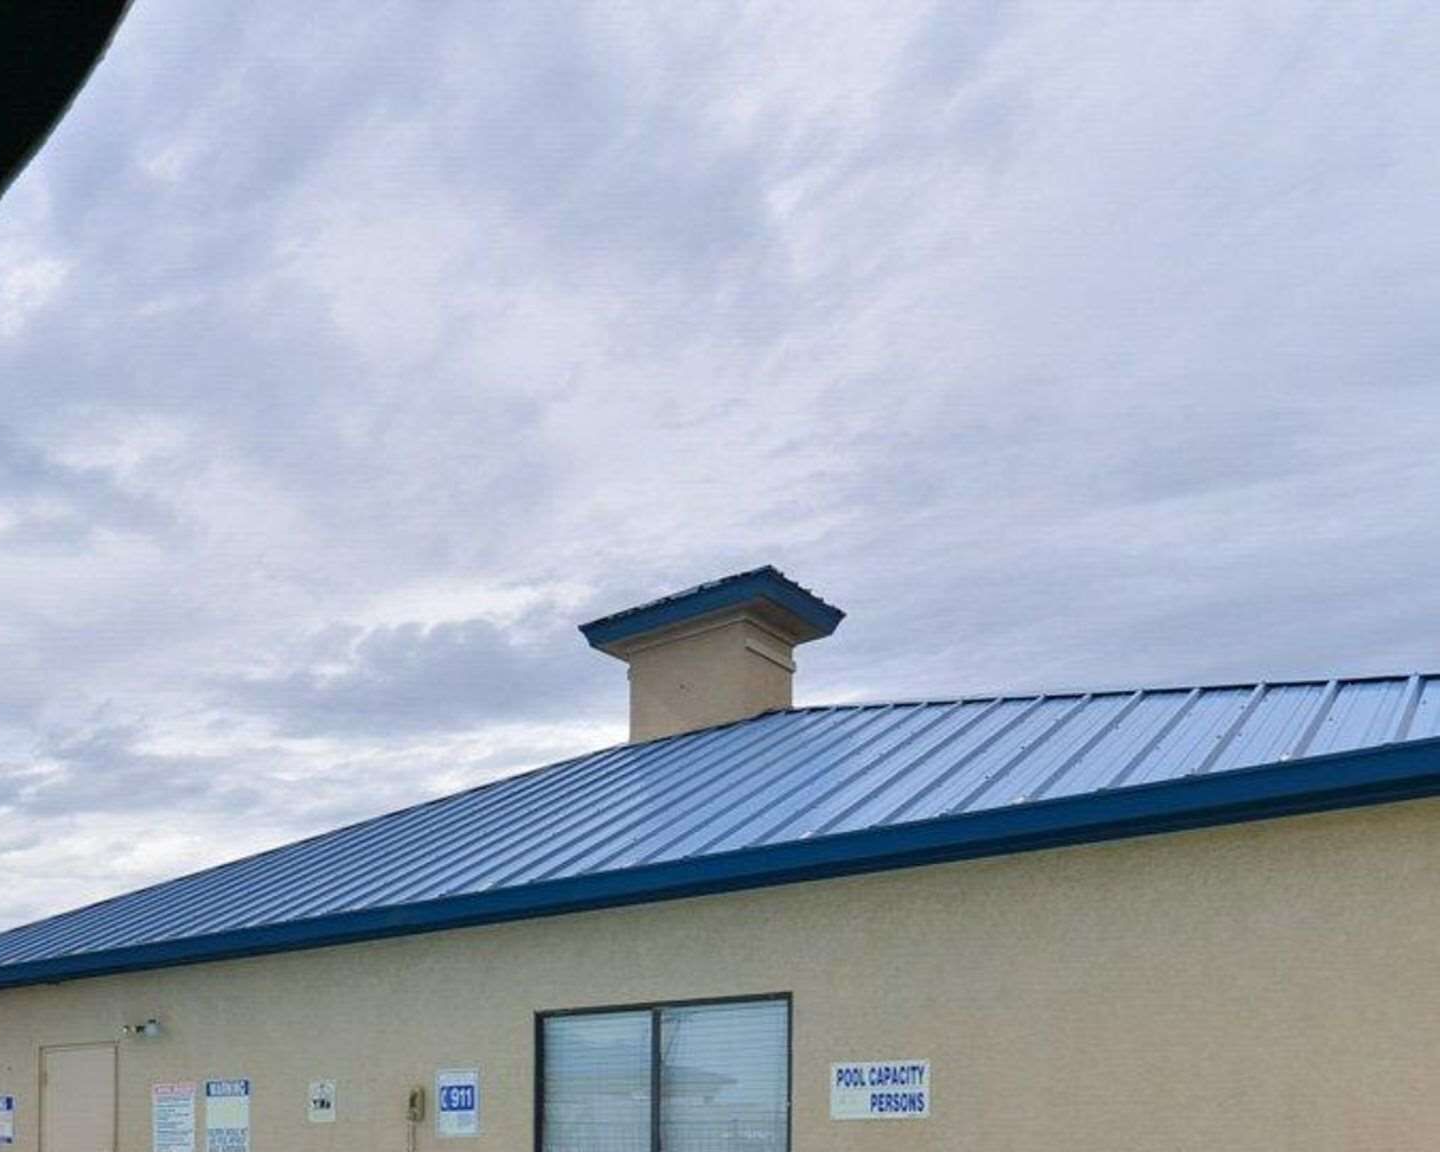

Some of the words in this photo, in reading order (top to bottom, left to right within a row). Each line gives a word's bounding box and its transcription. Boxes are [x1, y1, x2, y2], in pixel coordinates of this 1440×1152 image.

[836, 1068, 866, 1087] POOL
[868, 1065, 925, 1086] CAPACITY
[450, 1087, 473, 1108] 911
[870, 1091, 925, 1112] PERSONS
